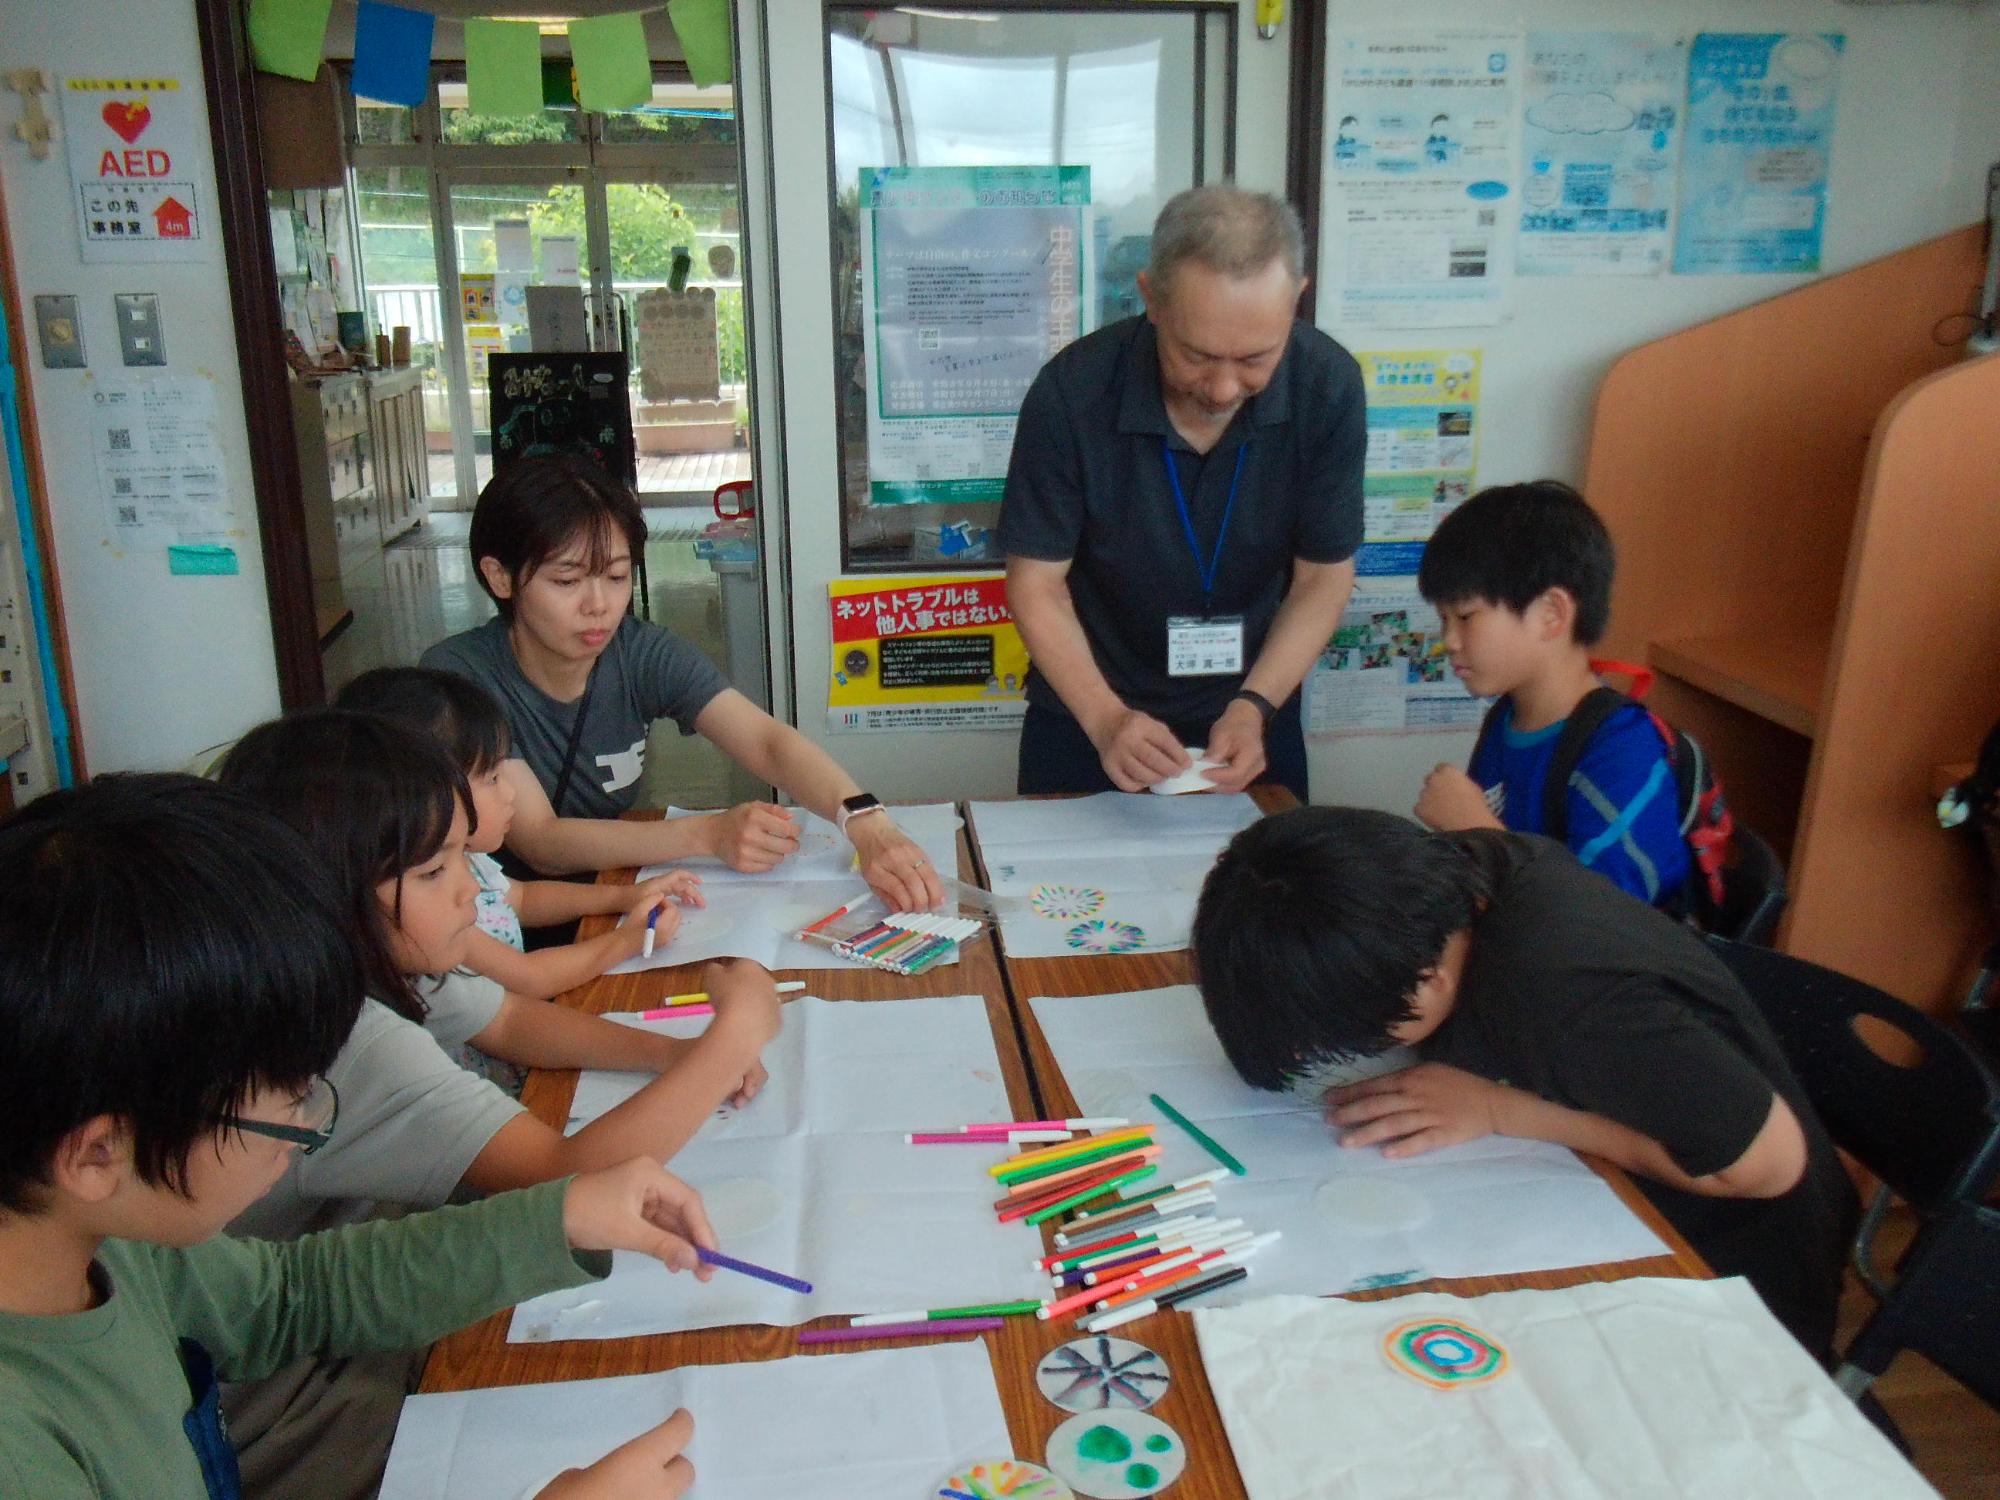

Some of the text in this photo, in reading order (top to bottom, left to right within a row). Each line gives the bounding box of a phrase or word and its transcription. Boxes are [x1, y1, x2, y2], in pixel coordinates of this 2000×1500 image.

[100, 150, 173, 178] AED
[91, 198, 139, 213] この先
[92, 220, 142, 235] 事務室
[166, 221, 184, 231] 4m
[837, 588, 979, 620] ネットトラブルは
[876, 605, 1013, 636] 他人事ではない
